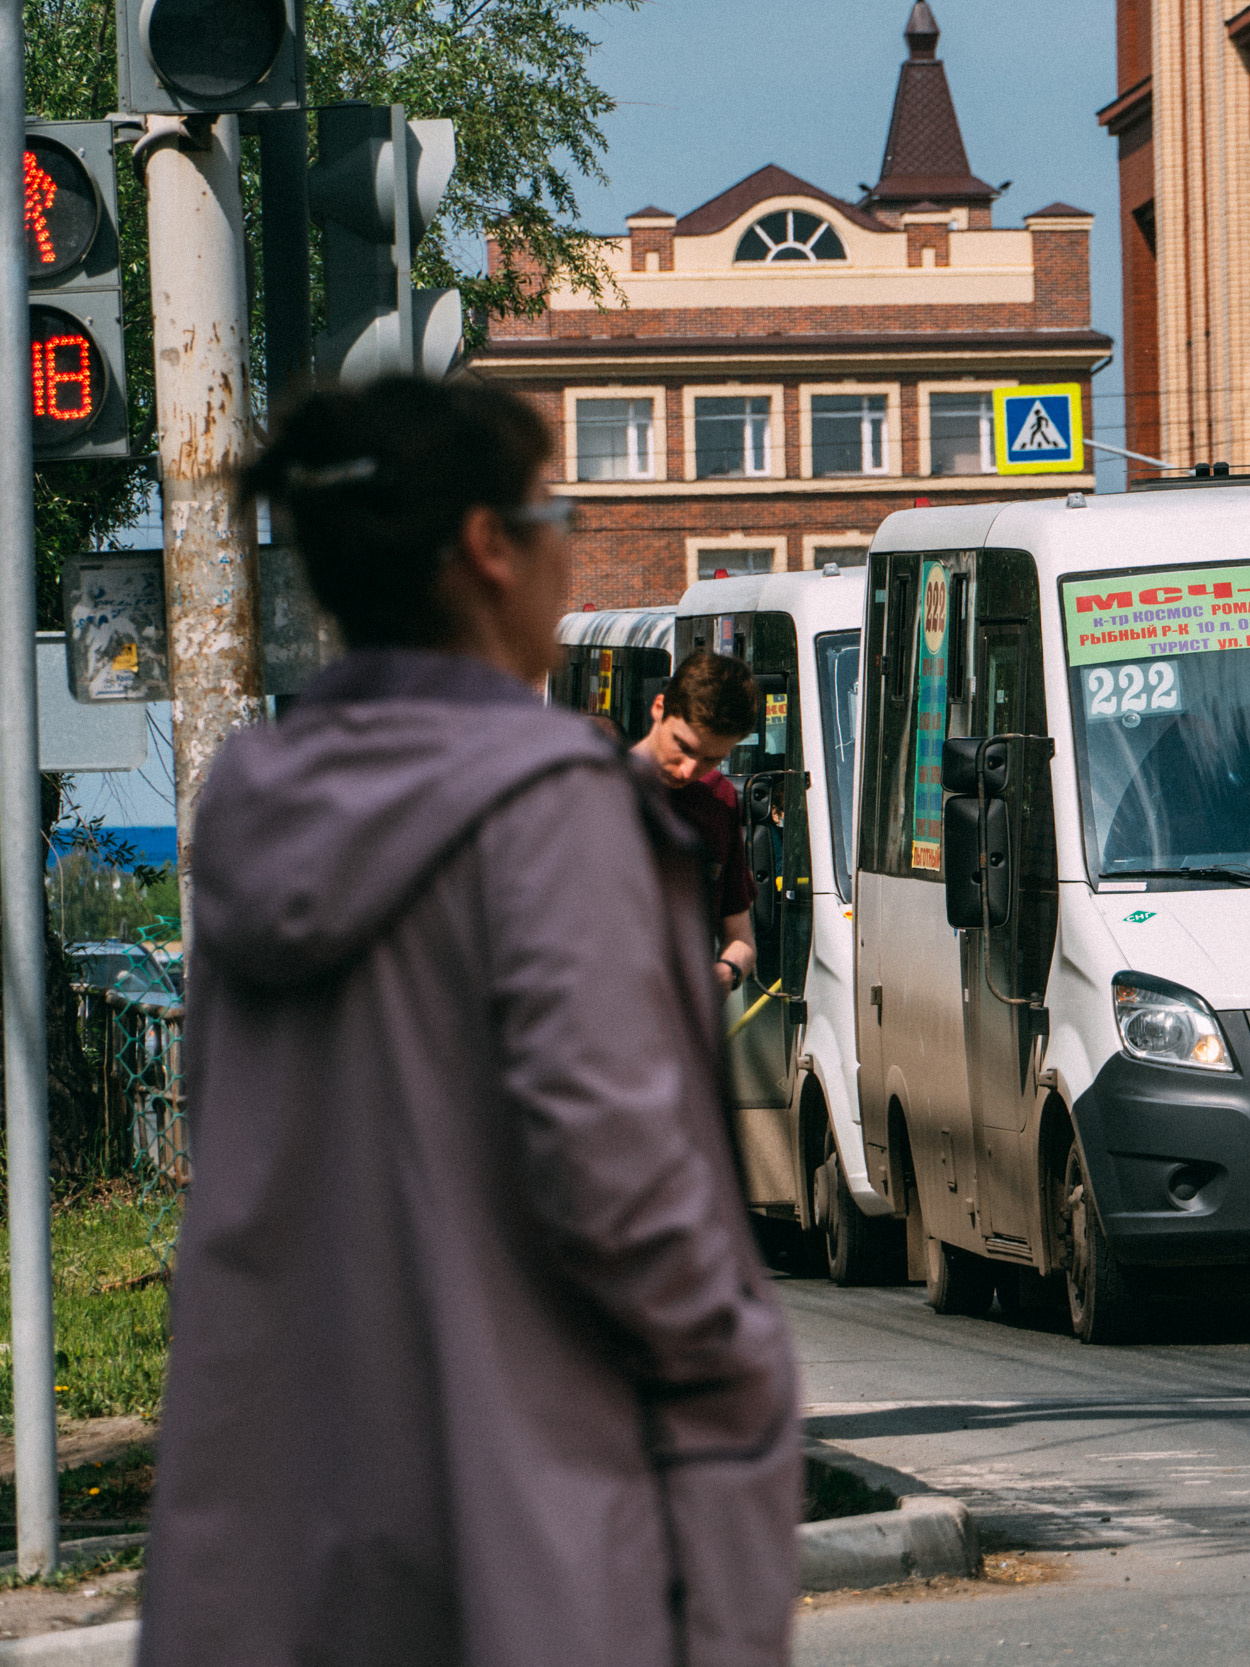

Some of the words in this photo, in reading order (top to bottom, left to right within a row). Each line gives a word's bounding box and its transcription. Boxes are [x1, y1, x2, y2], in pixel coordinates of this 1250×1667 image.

[31, 335, 92, 420] 18
[926, 581, 946, 633] 222
[1093, 614, 1129, 628] к-тр
[1133, 605, 1204, 623] КОСМОС
[1079, 624, 1158, 646] РЫБНЫЙ
[1162, 624, 1189, 637] Р-К
[1197, 622, 1216, 635] 10
[1148, 638, 1210, 655] ТУРИСТ
[1217, 637, 1244, 650] ул.
[1088, 661, 1177, 715] 222
[1126, 912, 1152, 922] СНГ
